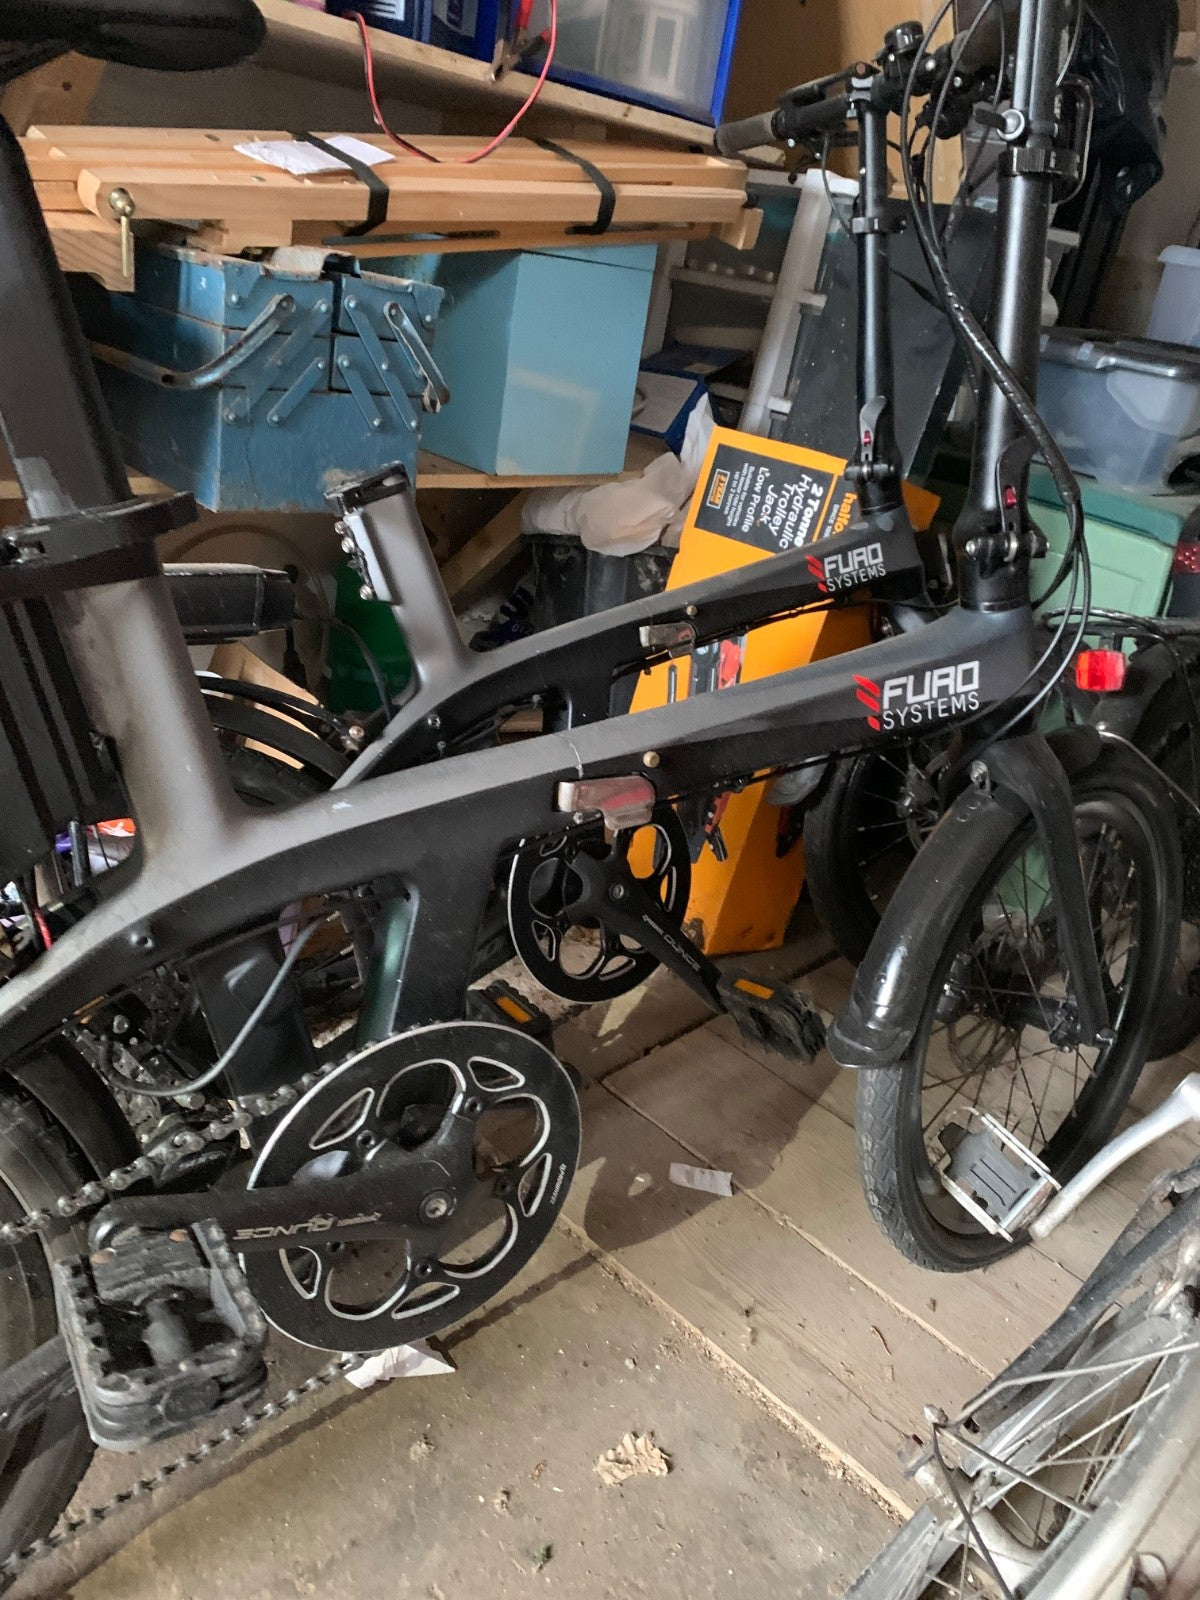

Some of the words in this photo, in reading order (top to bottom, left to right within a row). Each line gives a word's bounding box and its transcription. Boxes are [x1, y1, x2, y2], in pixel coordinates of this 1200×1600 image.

[740, 491, 748, 501] for
[754, 467, 769, 493] Low
[811, 483, 823, 497] 2
[741, 493, 761, 532] Profile
[761, 484, 778, 524] Jack
[768, 483, 796, 536] Trolley
[779, 474, 812, 549] Hydraulic
[794, 498, 820, 547] Tonne
[827, 563, 886, 592] SYSTEMS
[883, 691, 980, 730] SYSTEMS
